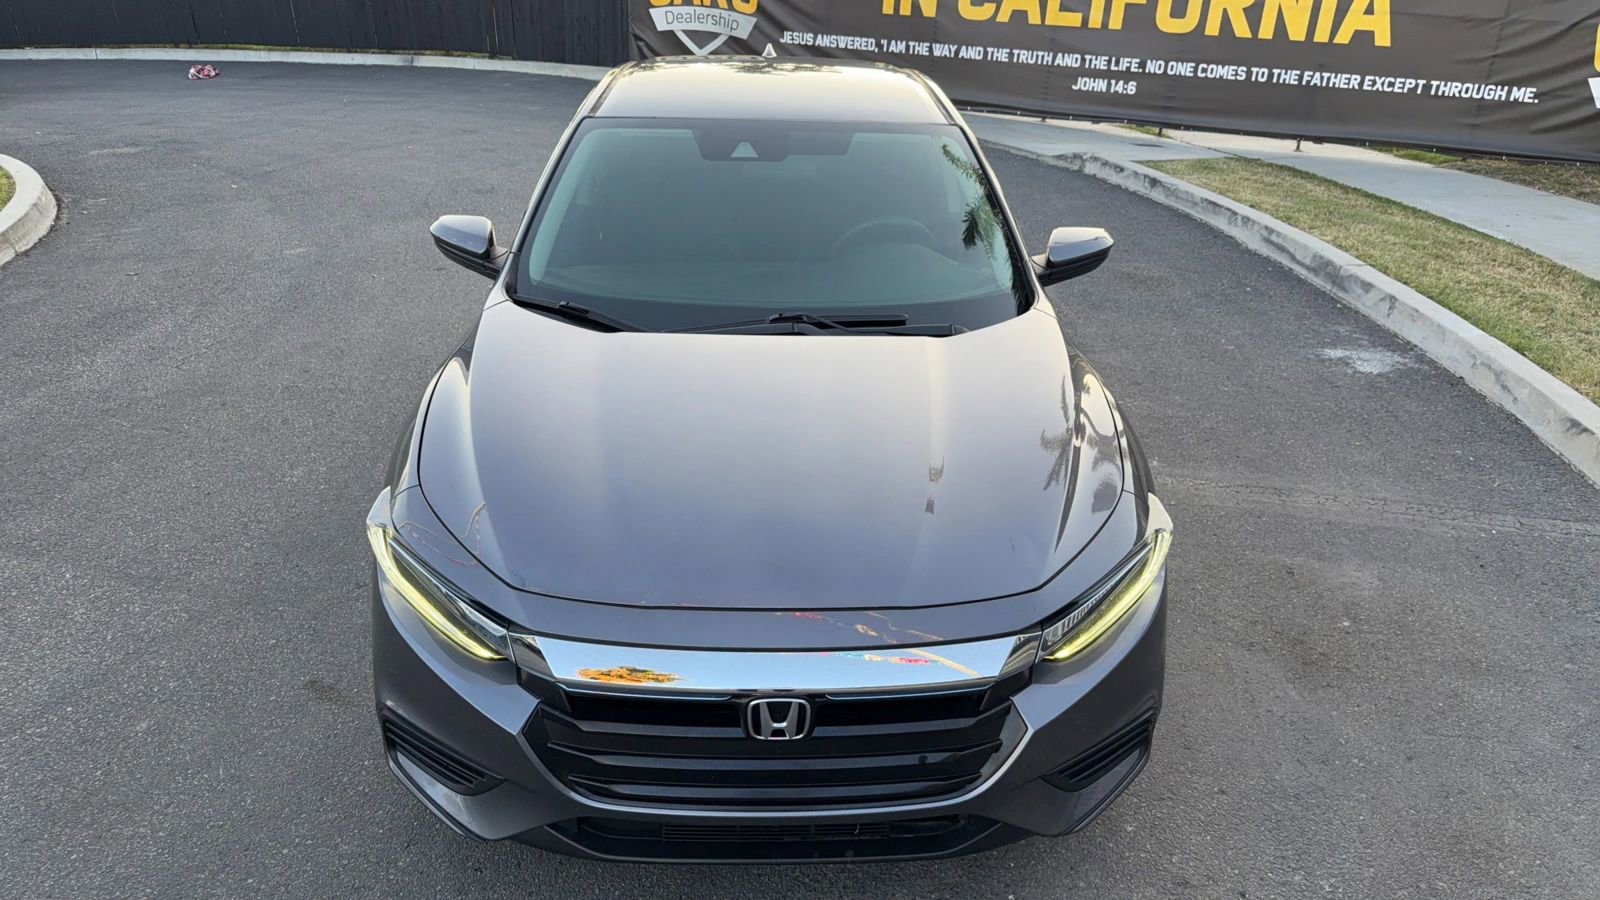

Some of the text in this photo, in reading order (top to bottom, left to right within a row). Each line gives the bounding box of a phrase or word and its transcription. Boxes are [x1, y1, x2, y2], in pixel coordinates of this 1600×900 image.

[664, 9, 739, 32] Dealership
[780, 32, 813, 45] JESUS
[815, 34, 878, 53] ANSWERED,
[889, 40, 906, 53] AM
[909, 42, 930, 55] THE
[933, 44, 957, 57] WAY
[959, 46, 983, 60] AND
[987, 47, 1010, 62] THE
[1013, 49, 1053, 65] TRUTH
[1054, 53, 1081, 67] AND
[1085, 55, 1109, 69] THE
[1111, 57, 1142, 72] LIFE.
[1146, 60, 1165, 74] NO
[1167, 61, 1195, 76] ONE
[1197, 64, 1247, 80] COMES
[1251, 67, 1268, 82] TO
[1272, 69, 1300, 84] THE
[1302, 71, 1361, 89] FATHER
[1363, 76, 1426, 94] EXCEPT
[1431, 80, 1508, 100] THROUGH
[1510, 87, 1538, 103] ME.
[1072, 77, 1137, 94] JOHN 14:6
